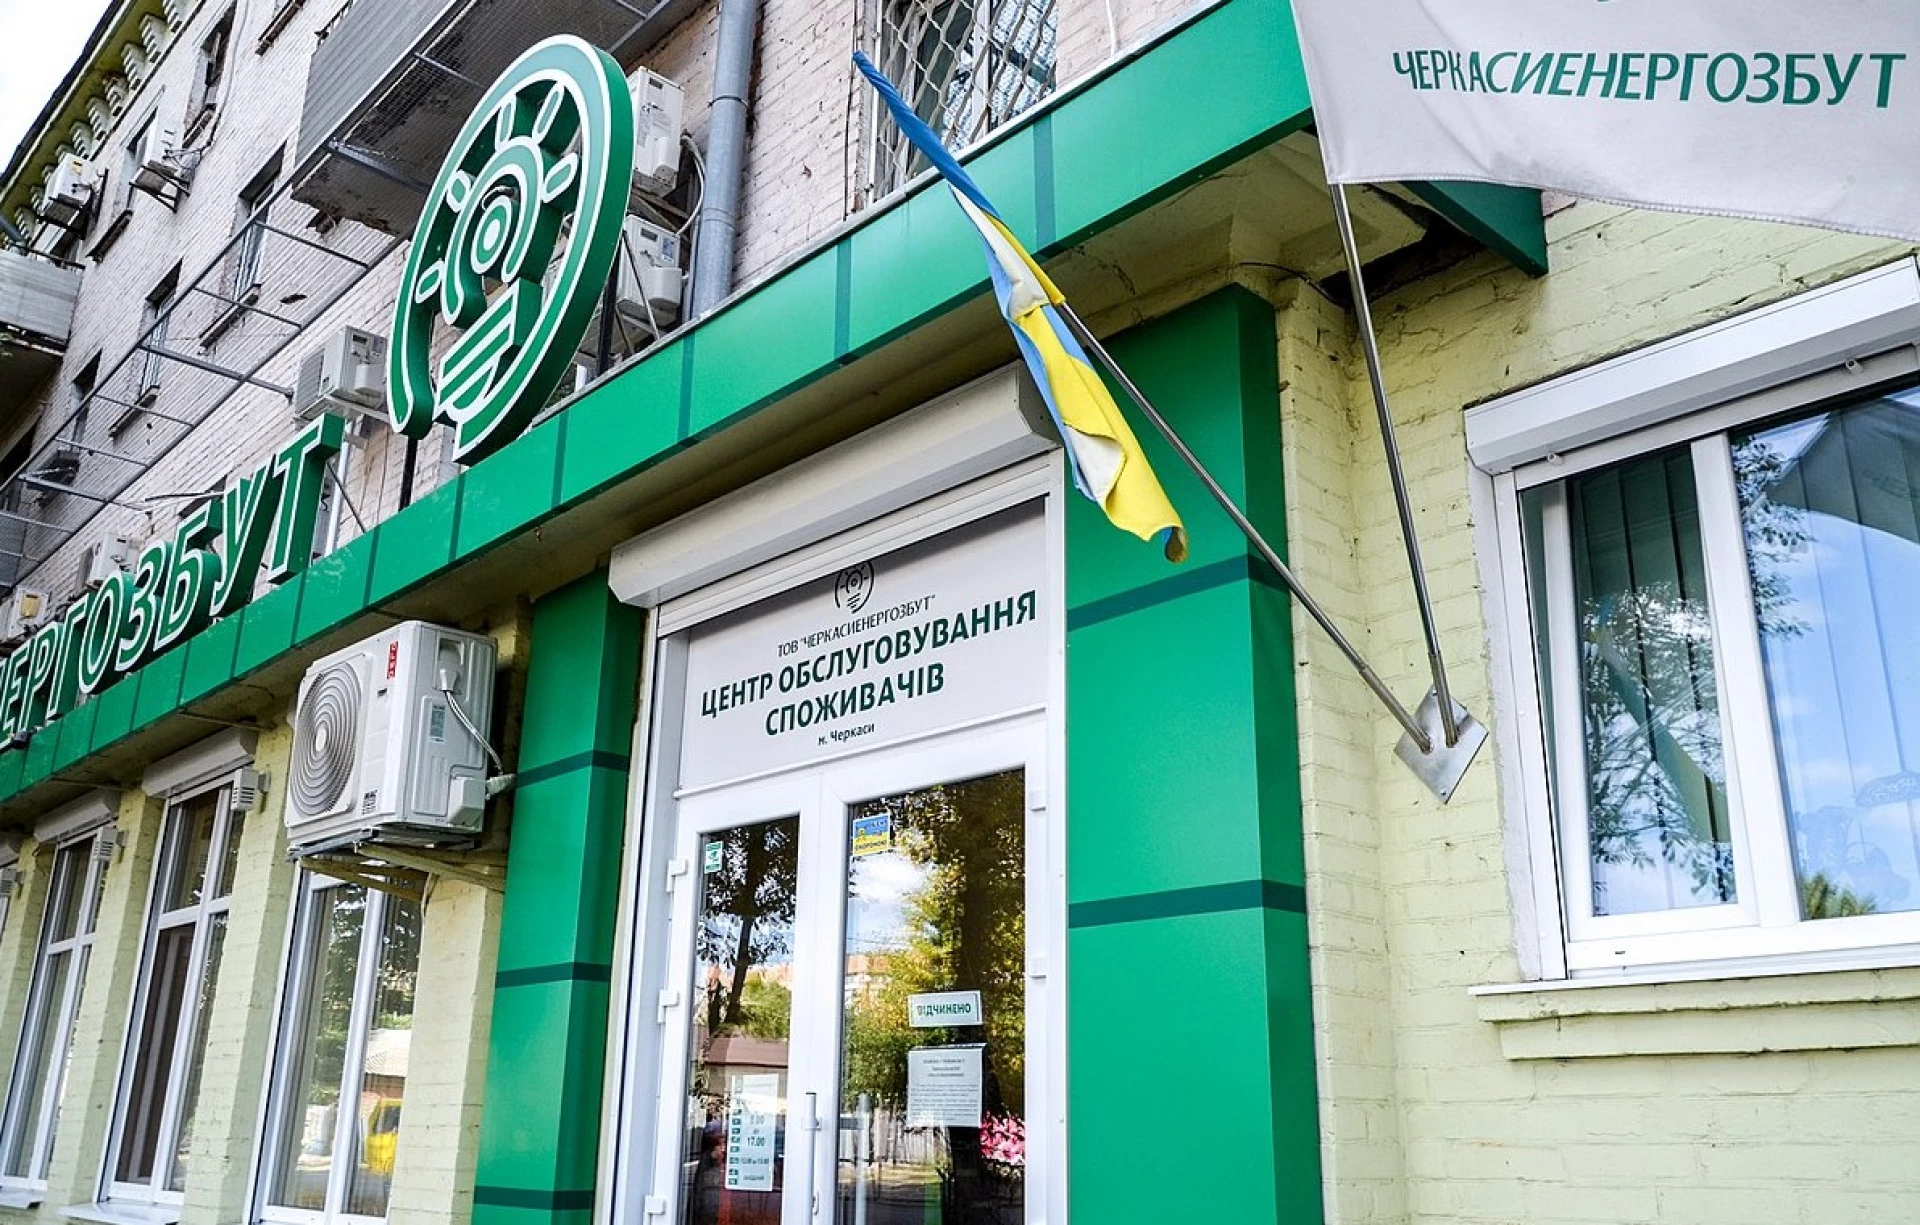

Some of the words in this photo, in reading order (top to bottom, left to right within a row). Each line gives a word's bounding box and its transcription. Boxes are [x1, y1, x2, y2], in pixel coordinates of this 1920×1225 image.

[1393, 49, 1907, 109] ЧЕРКАСИЕНЕРГОЗБУТ
[0, 412, 328, 749] ЕРГОЗБУТ
[701, 673, 773, 718] ЦЕНТР
[778, 590, 1036, 693] ОБСЛУГОВУВАННЯ
[778, 639, 799, 658] ТОВ
[765, 662, 944, 736] СПОЖИВАЧІВ
[830, 723, 875, 743] Черкаси
